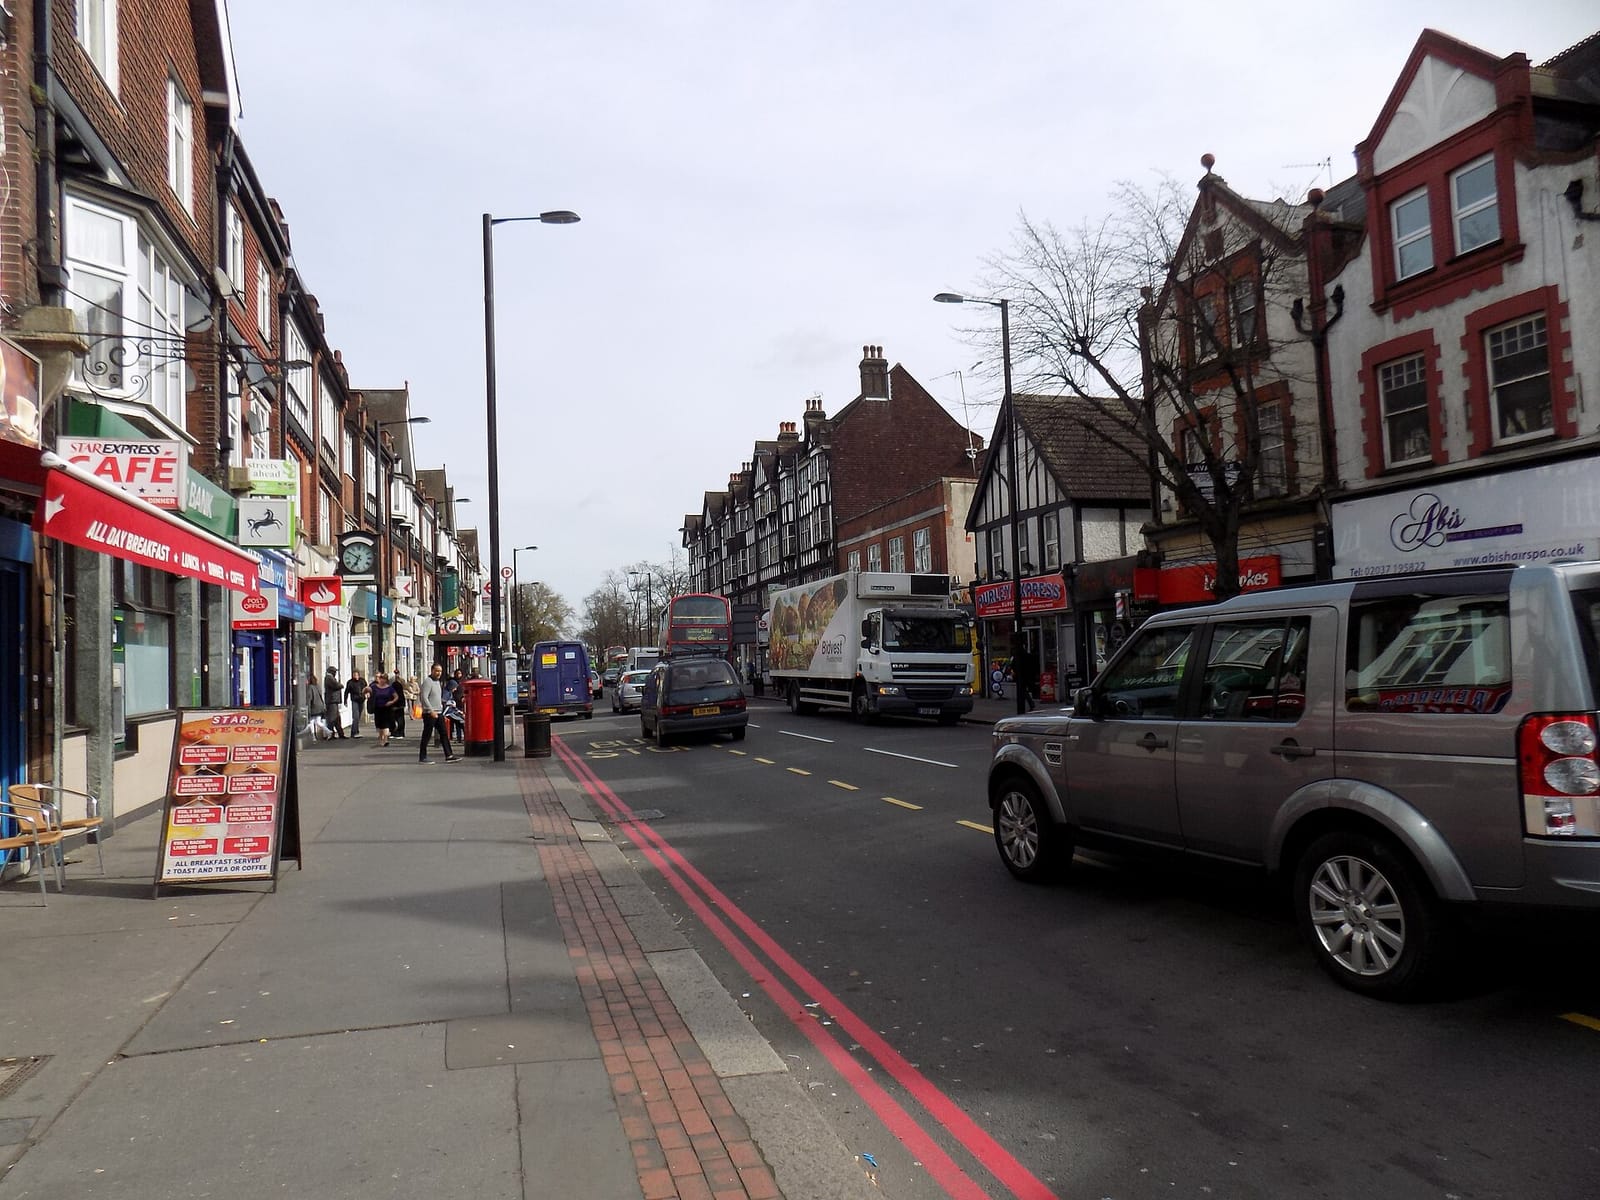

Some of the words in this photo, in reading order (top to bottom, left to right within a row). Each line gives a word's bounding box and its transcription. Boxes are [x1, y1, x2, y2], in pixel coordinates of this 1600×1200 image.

[70, 442, 103, 455] STAR
[102, 443, 161, 455] EXPRESS
[248, 461, 279, 470] streets
[254, 469, 281, 478] ahead
[147, 497, 176, 505] DINNER
[188, 481, 214, 520] BANK
[86, 519, 108, 543] ALL
[107, 526, 128, 550] DAY
[127, 532, 171, 563] BREAKFAST
[181, 551, 200, 572] LUNCH
[1453, 543, 1585, 567] www.abishairspa.co.uk
[1350, 568, 1364, 577] Tel:
[1364, 565, 1391, 576] 02037
[1393, 561, 1426, 574] 195822
[977, 583, 1012, 609] PURLEY
[1020, 581, 1061, 601] XPRESS
[821, 640, 843, 655] Bidvest
[212, 715, 248, 725] STAR
[233, 726, 281, 736] OPEN
